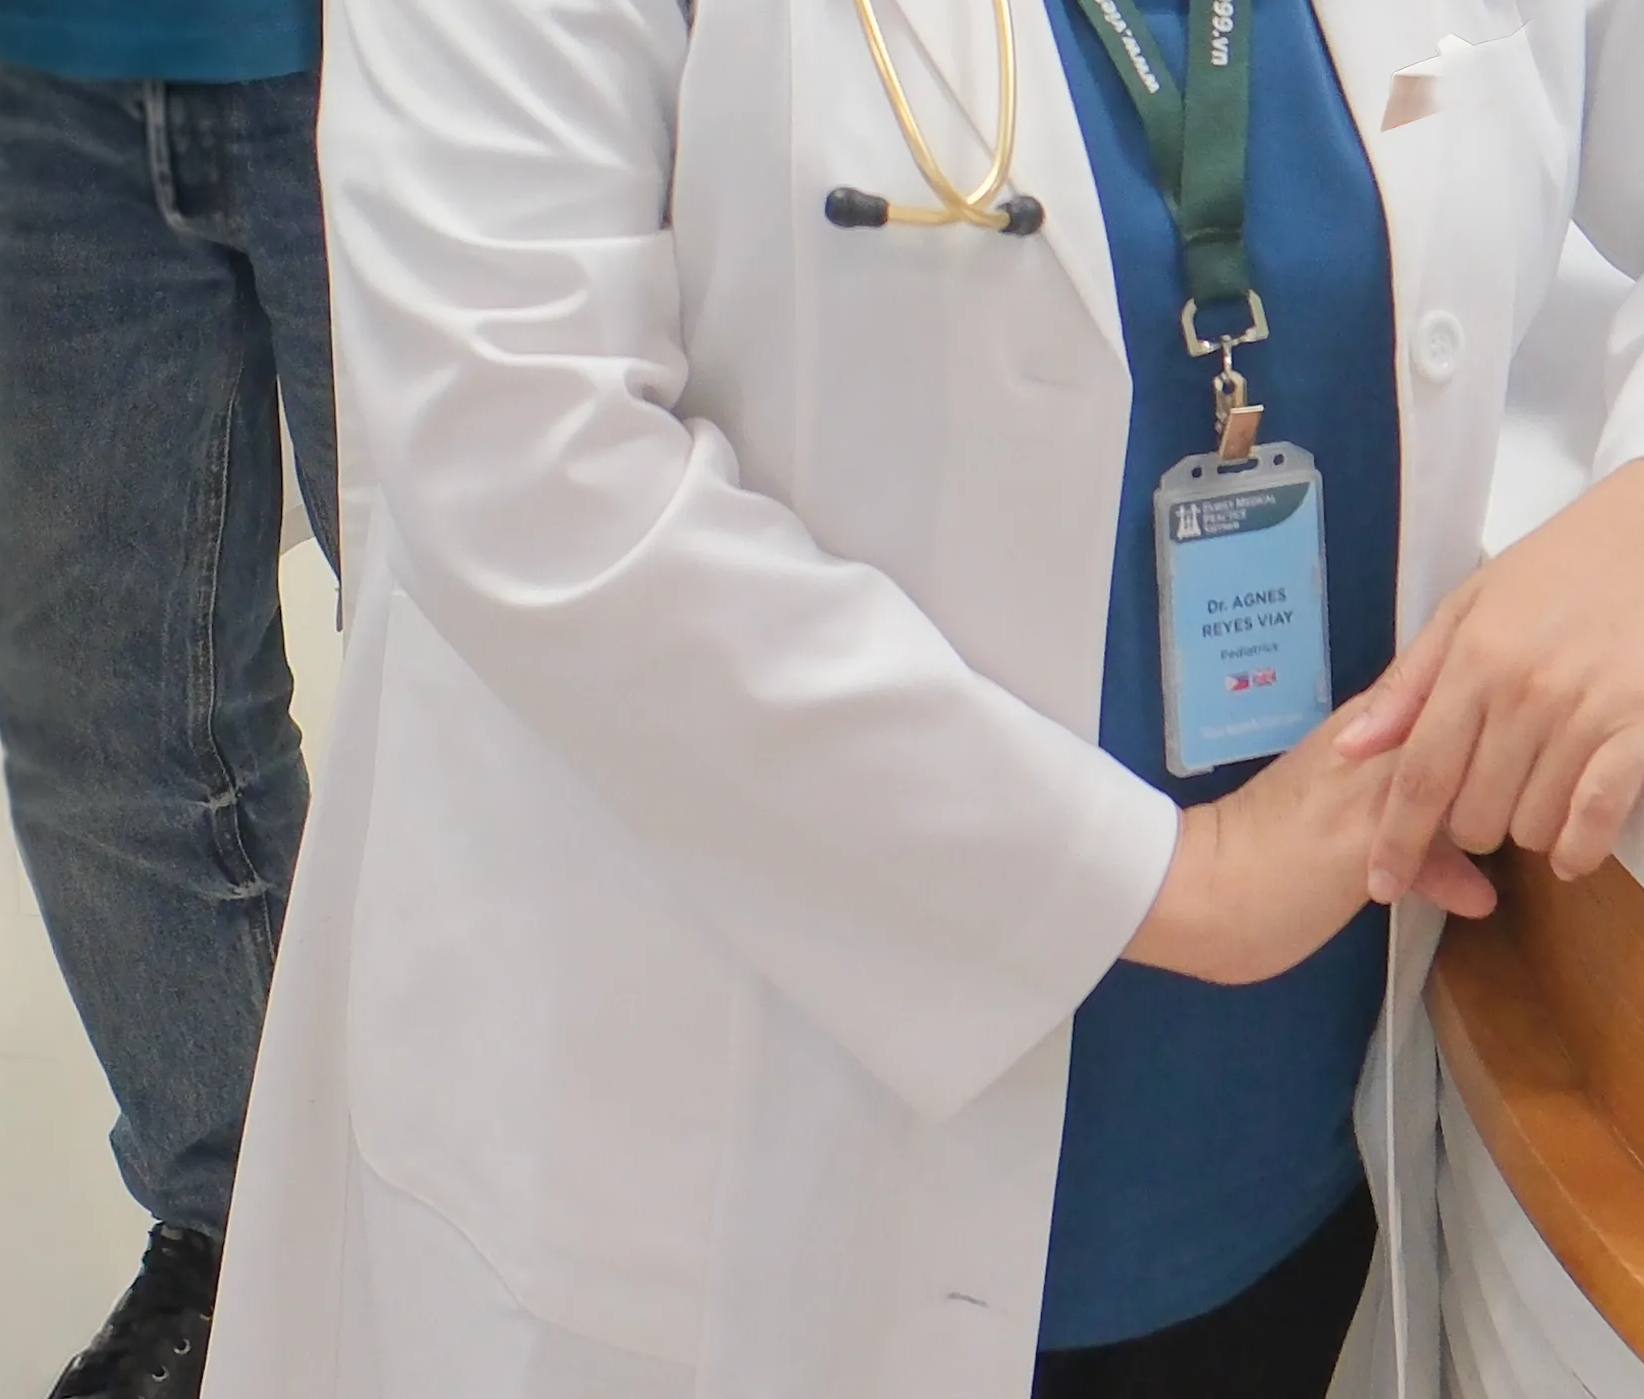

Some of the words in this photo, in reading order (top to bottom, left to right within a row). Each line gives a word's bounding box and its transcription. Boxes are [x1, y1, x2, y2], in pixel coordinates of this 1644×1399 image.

[1207, 598, 1227, 615] Dr.
[1232, 587, 1287, 611] AGNES
[1202, 617, 1253, 638] REYES
[1257, 609, 1293, 630] VIAY
